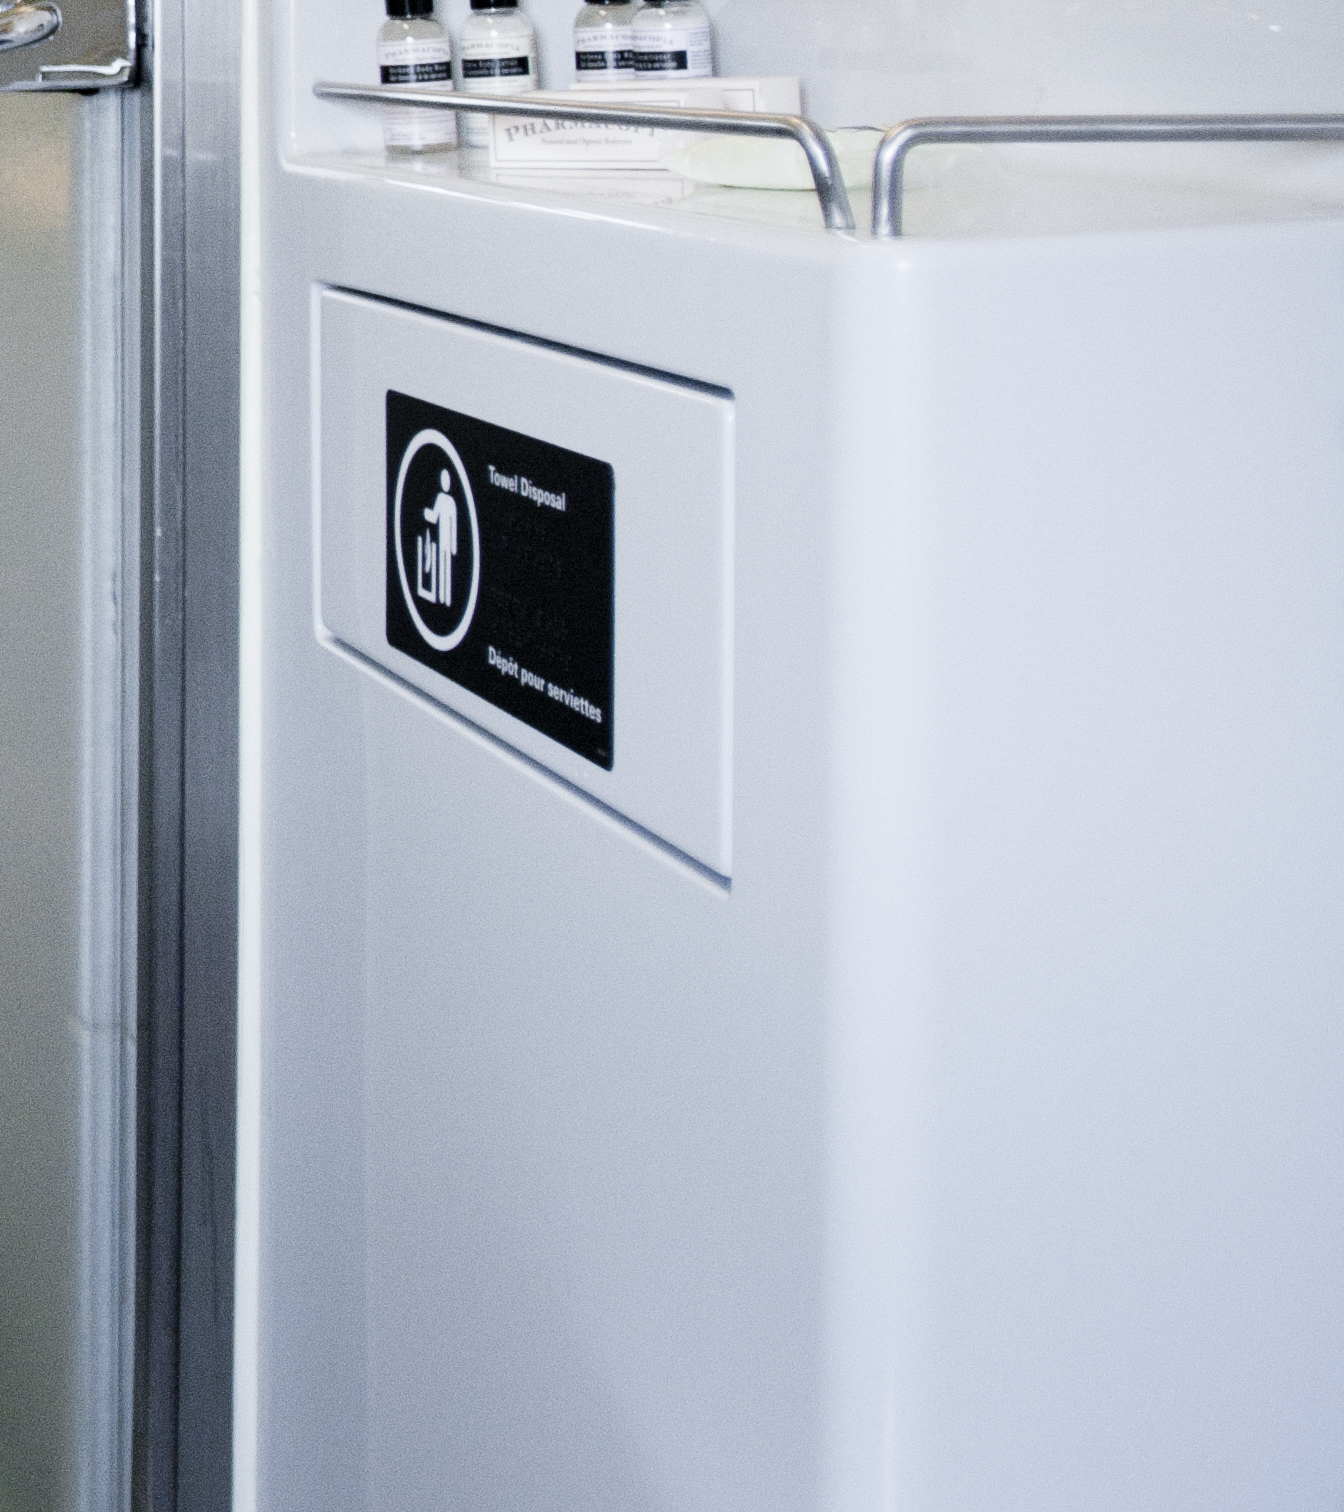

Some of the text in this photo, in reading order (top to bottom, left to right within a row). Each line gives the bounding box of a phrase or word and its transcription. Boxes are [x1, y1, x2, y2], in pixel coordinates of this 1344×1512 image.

[488, 464, 566, 512] Towel Disposal
[487, 645, 603, 724] Dépôt pour serviettes
